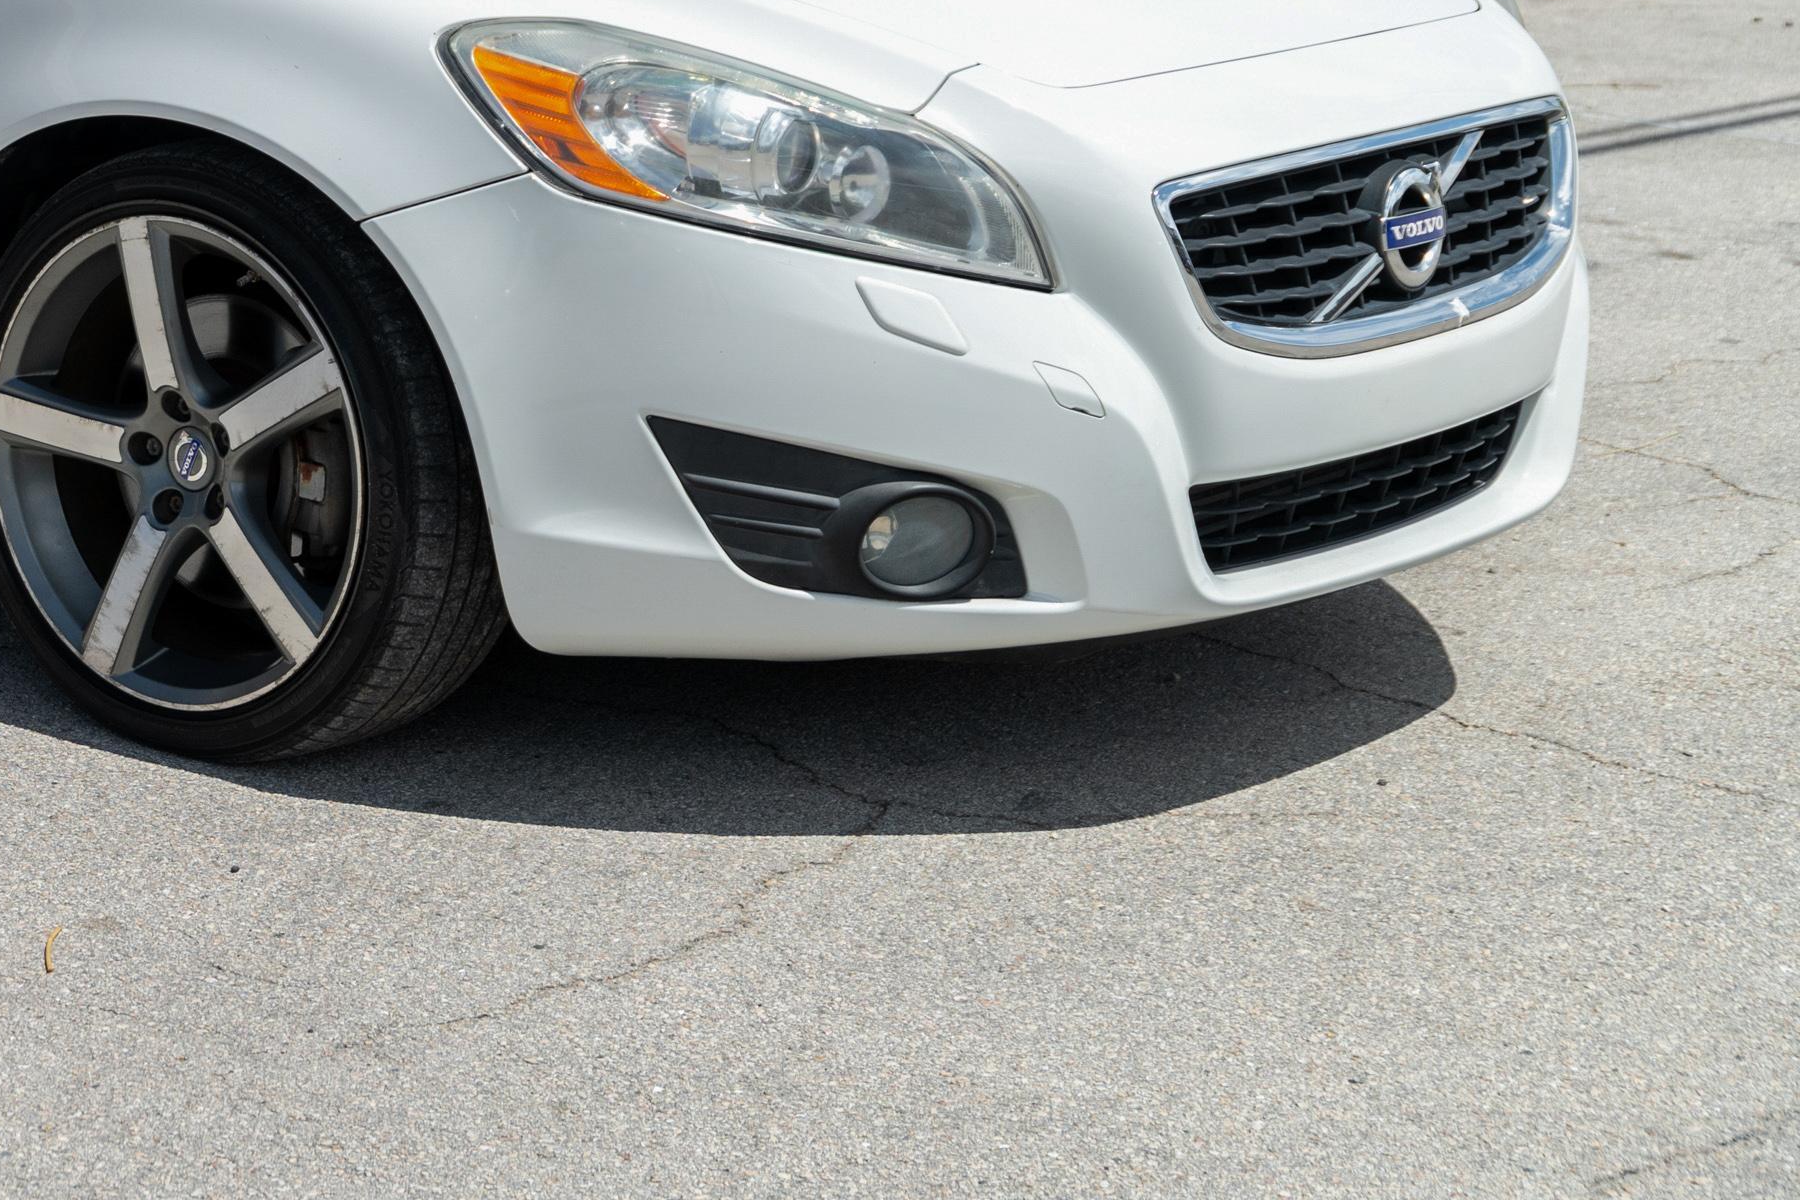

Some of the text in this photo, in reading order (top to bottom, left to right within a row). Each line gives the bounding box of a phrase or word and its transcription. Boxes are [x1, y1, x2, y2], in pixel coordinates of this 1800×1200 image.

[1390, 215, 1444, 241] VOLVO
[180, 442, 198, 476] VOLVO
[365, 469, 396, 592] YOKOHAMA
